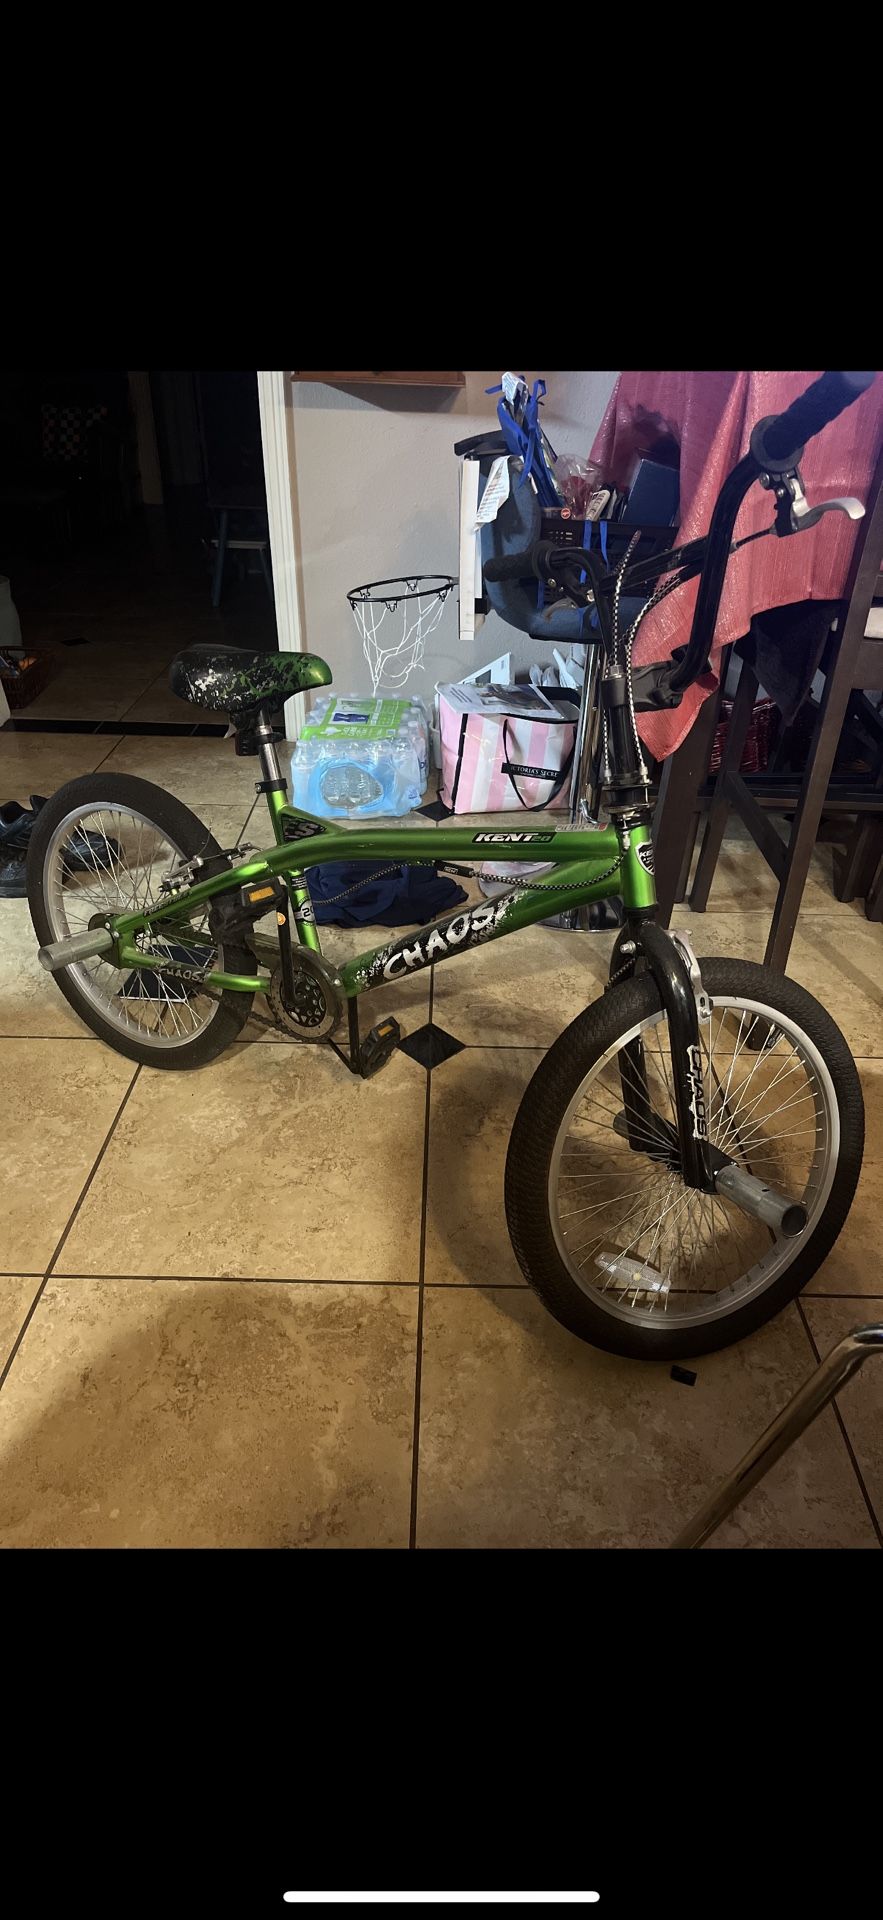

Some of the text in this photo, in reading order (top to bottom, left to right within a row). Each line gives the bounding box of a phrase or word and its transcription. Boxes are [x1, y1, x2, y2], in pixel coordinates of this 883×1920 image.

[540, 768, 559, 777] SECRE
[475, 832, 538, 842] KENT
[383, 898, 496, 980] CHAOS
[157, 968, 203, 981] CHAOS
[692, 1049, 707, 1136] CHAOS
